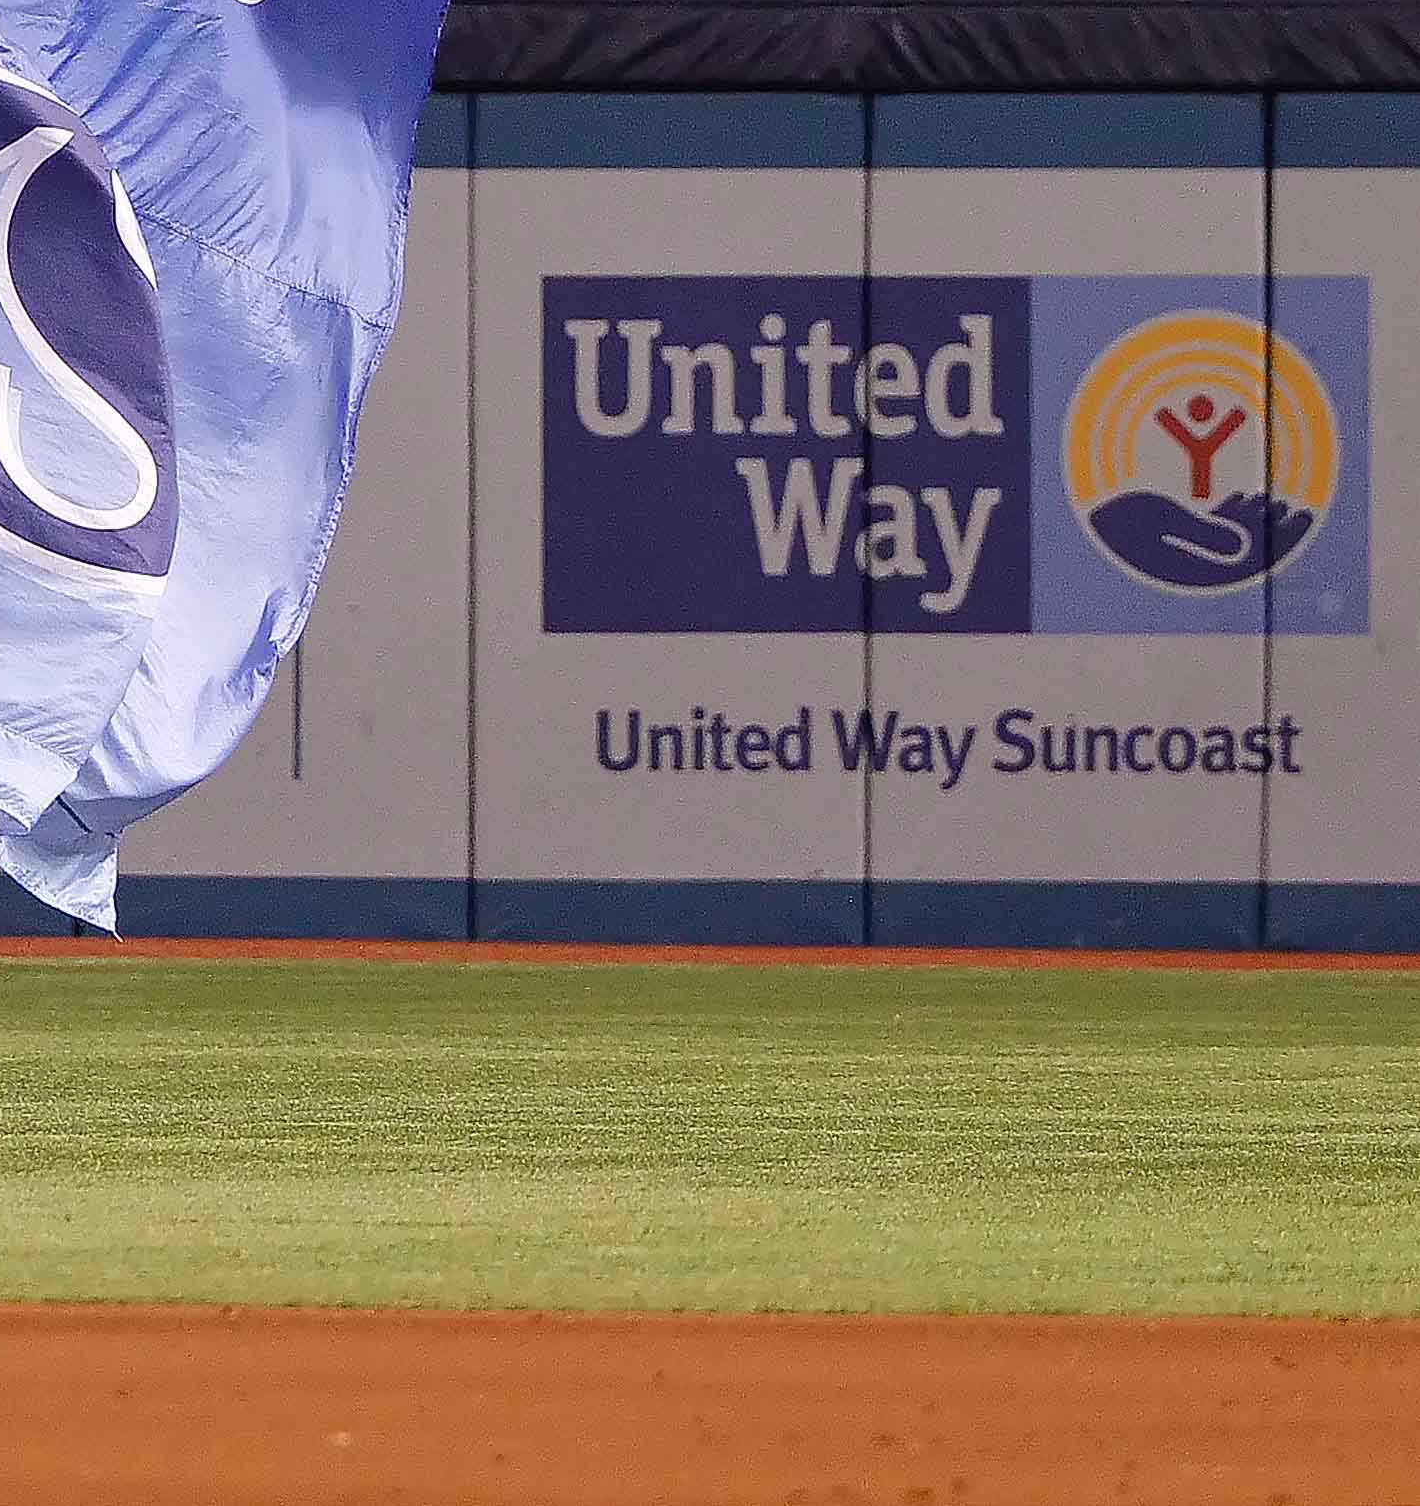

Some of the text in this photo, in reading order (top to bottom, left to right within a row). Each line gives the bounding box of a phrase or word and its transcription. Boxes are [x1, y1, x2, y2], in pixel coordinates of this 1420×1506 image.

[564, 312, 1006, 438] United
[734, 454, 1003, 614] Way
[595, 706, 1303, 791] United Way Suncoast
